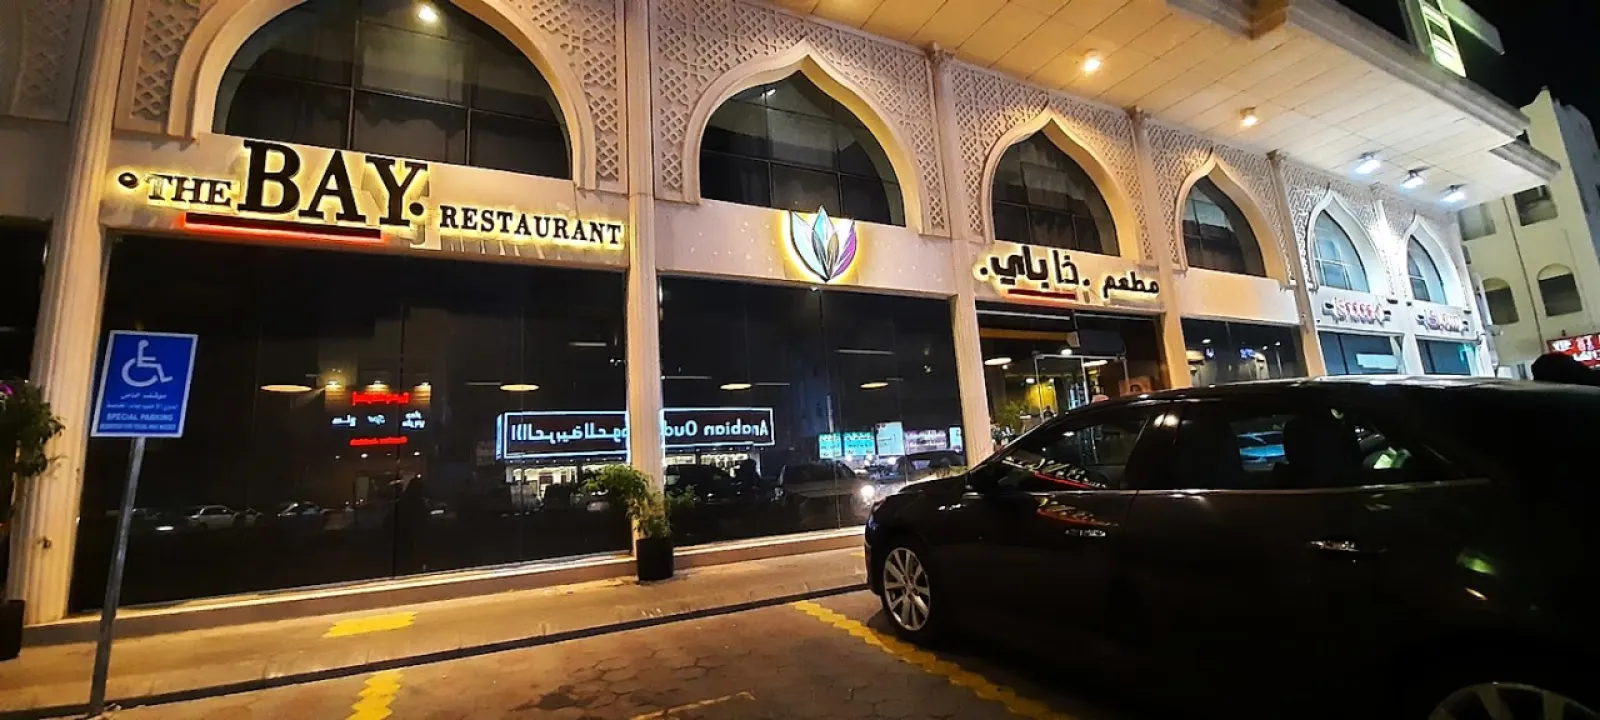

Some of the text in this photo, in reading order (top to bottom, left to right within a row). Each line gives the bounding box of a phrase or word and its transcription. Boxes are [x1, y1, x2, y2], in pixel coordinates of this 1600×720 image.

[147, 139, 623, 246] THE BAY RESTAURANT
[990, 244, 1050, 290] باي
[1102, 271, 1160, 299] مطعم
[106, 413, 174, 421] SPECIAL PARKING
